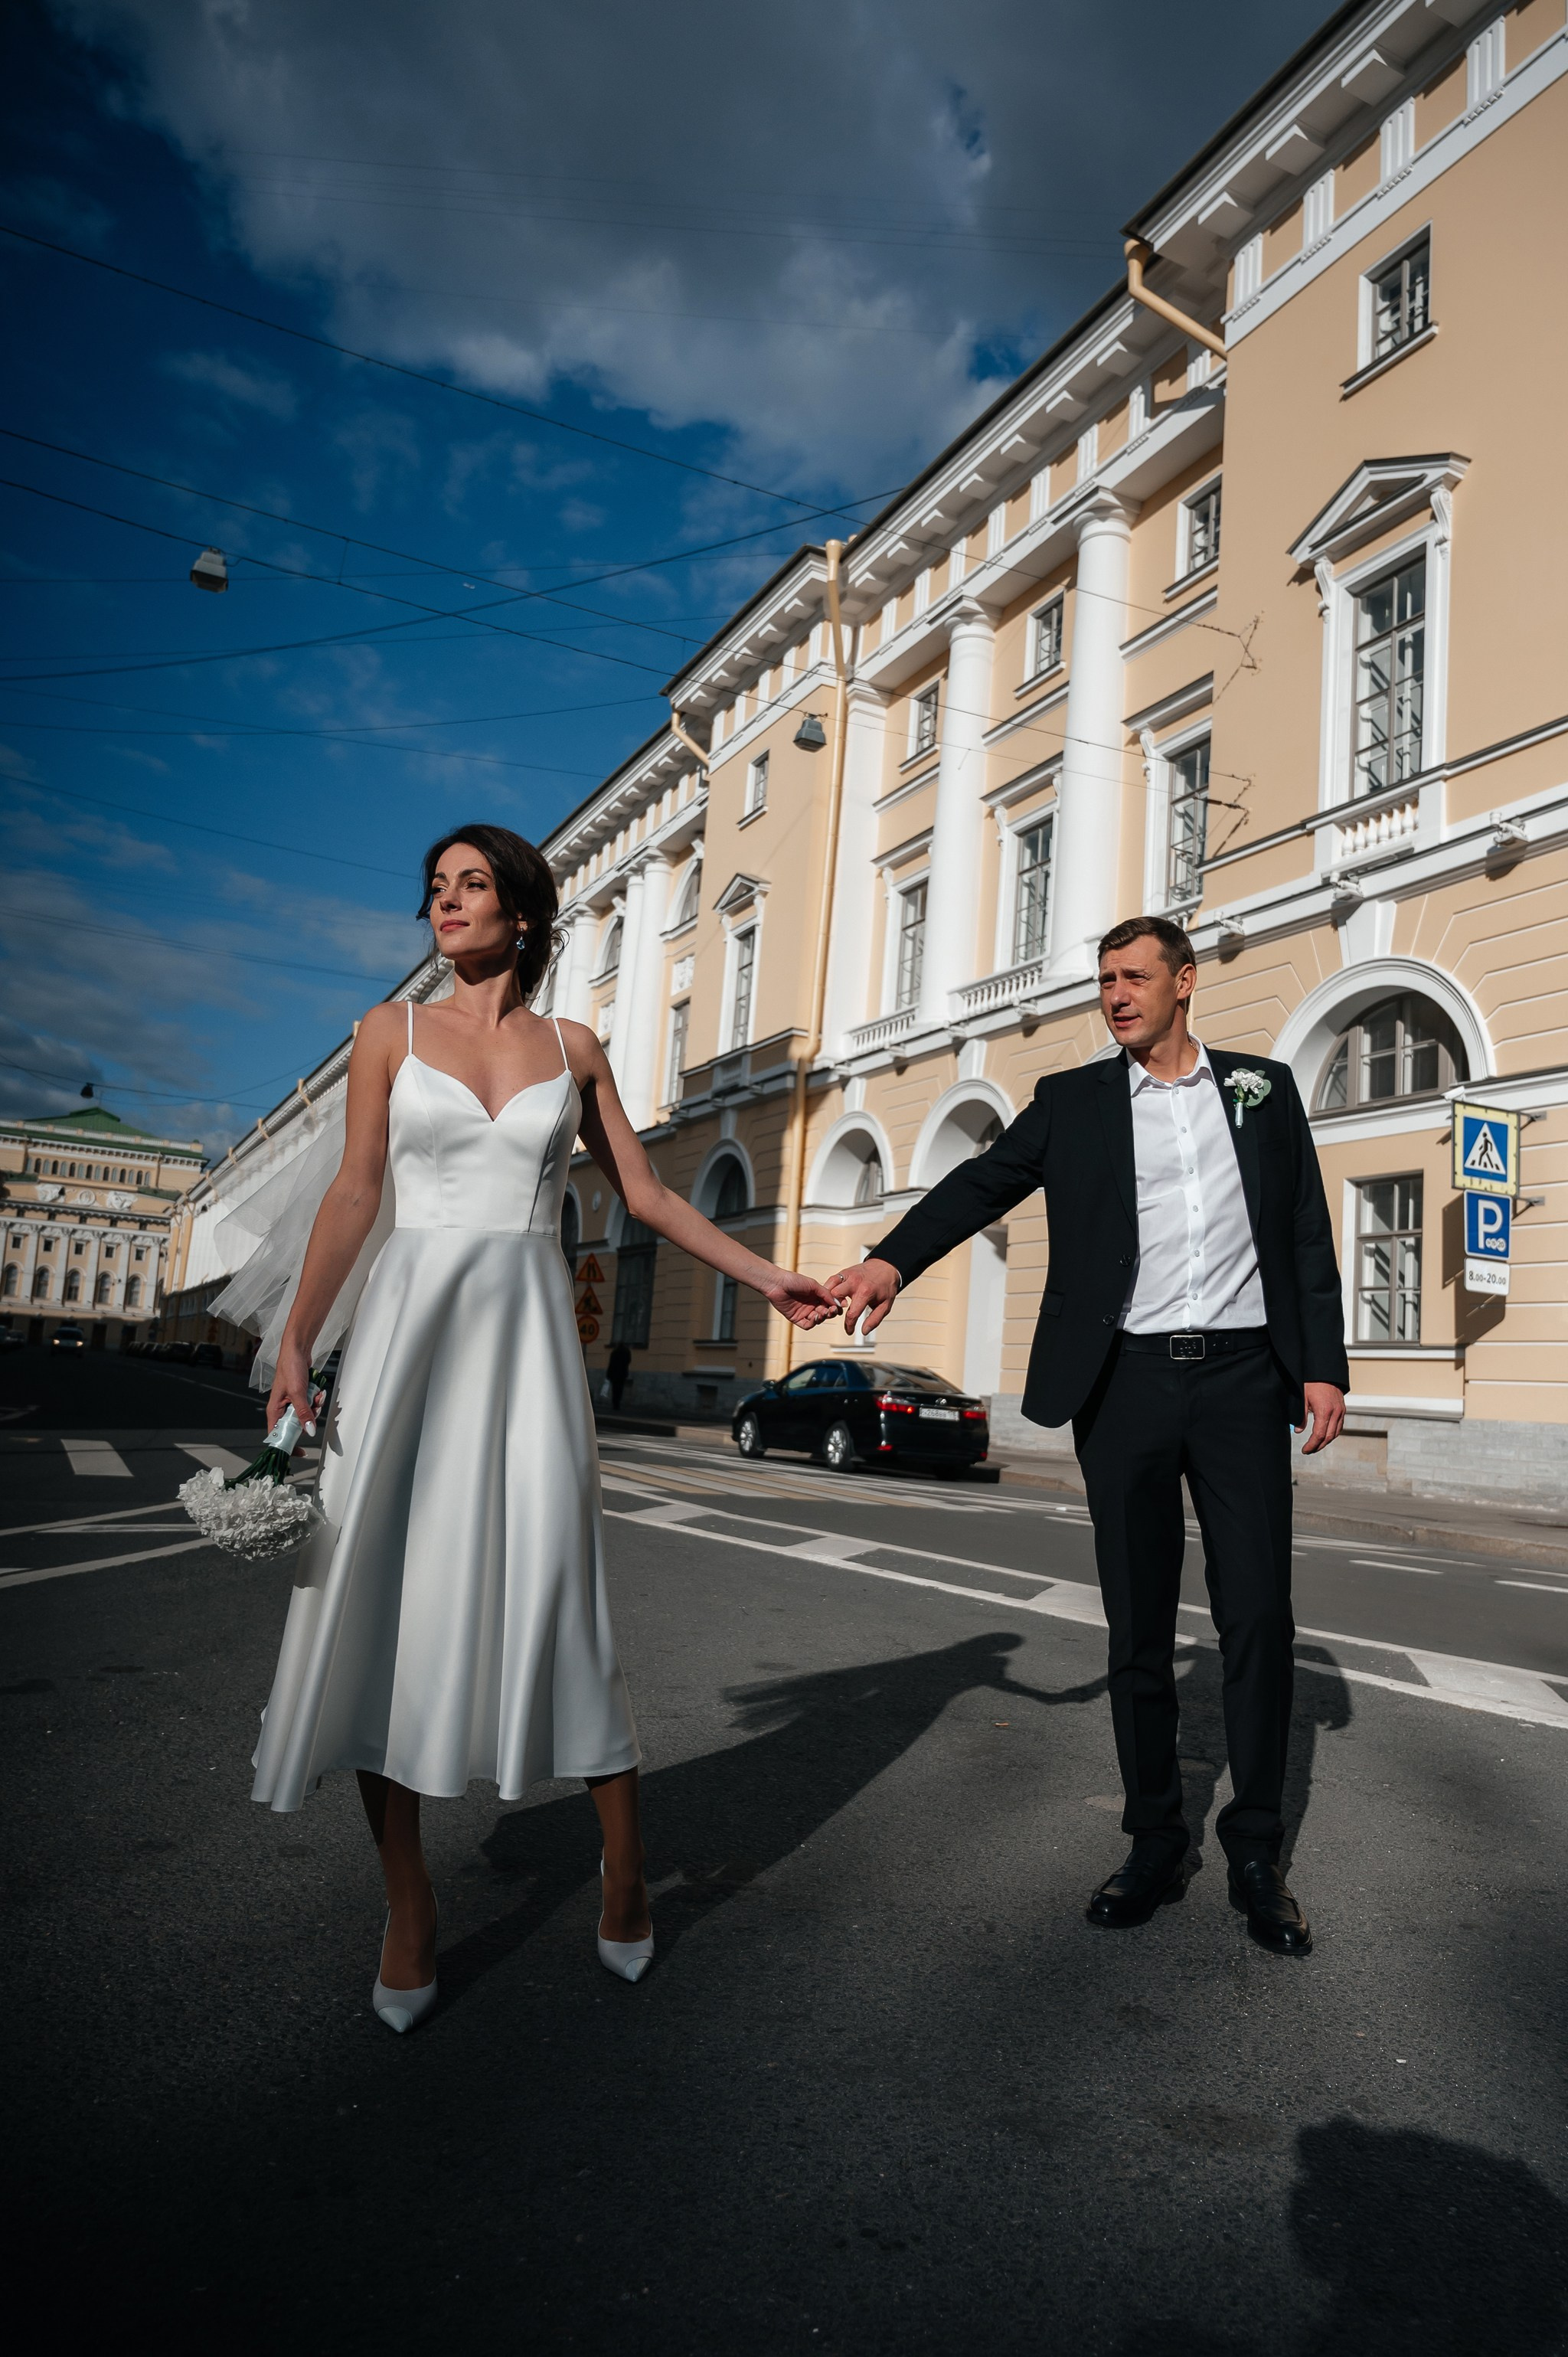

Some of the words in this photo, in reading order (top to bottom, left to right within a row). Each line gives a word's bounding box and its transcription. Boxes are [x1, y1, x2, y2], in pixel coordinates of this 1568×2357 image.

[1478, 1199, 1503, 1250] P
[1498, 1240, 1504, 1248] 20
[580, 1323, 595, 1335] 40
